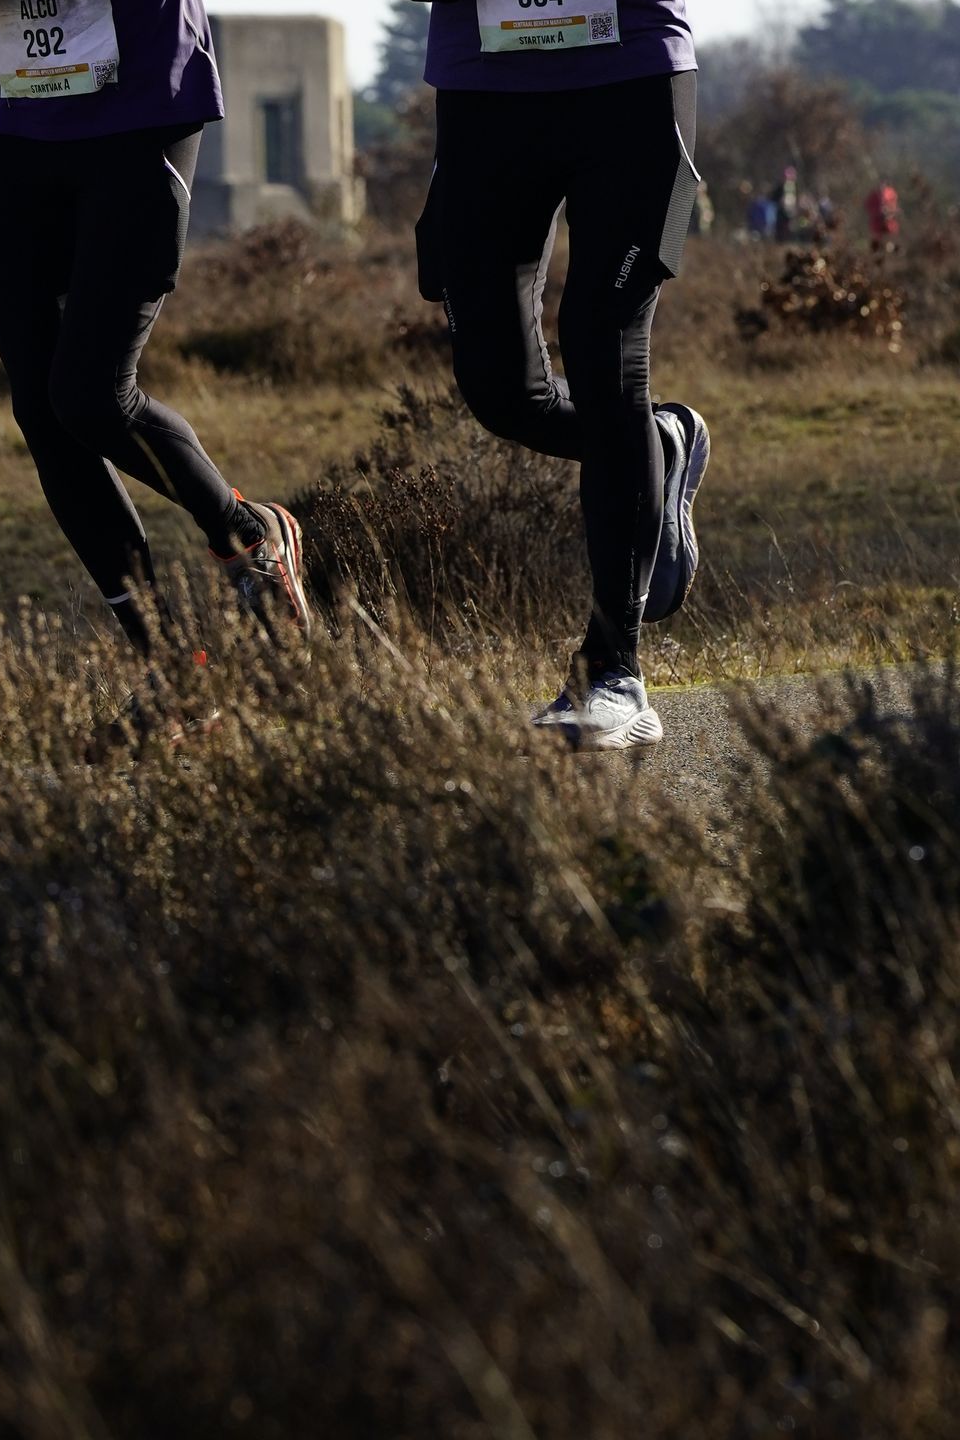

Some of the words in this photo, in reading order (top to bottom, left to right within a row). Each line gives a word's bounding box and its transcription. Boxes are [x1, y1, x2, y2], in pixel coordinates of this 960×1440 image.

[23, 27, 67, 58] 292
[519, 34, 556, 45] STARTVAK
[557, 31, 565, 43] A
[30, 82, 63, 94] STARTVAK
[64, 78, 71, 90] A
[614, 245, 641, 289] FUSION
